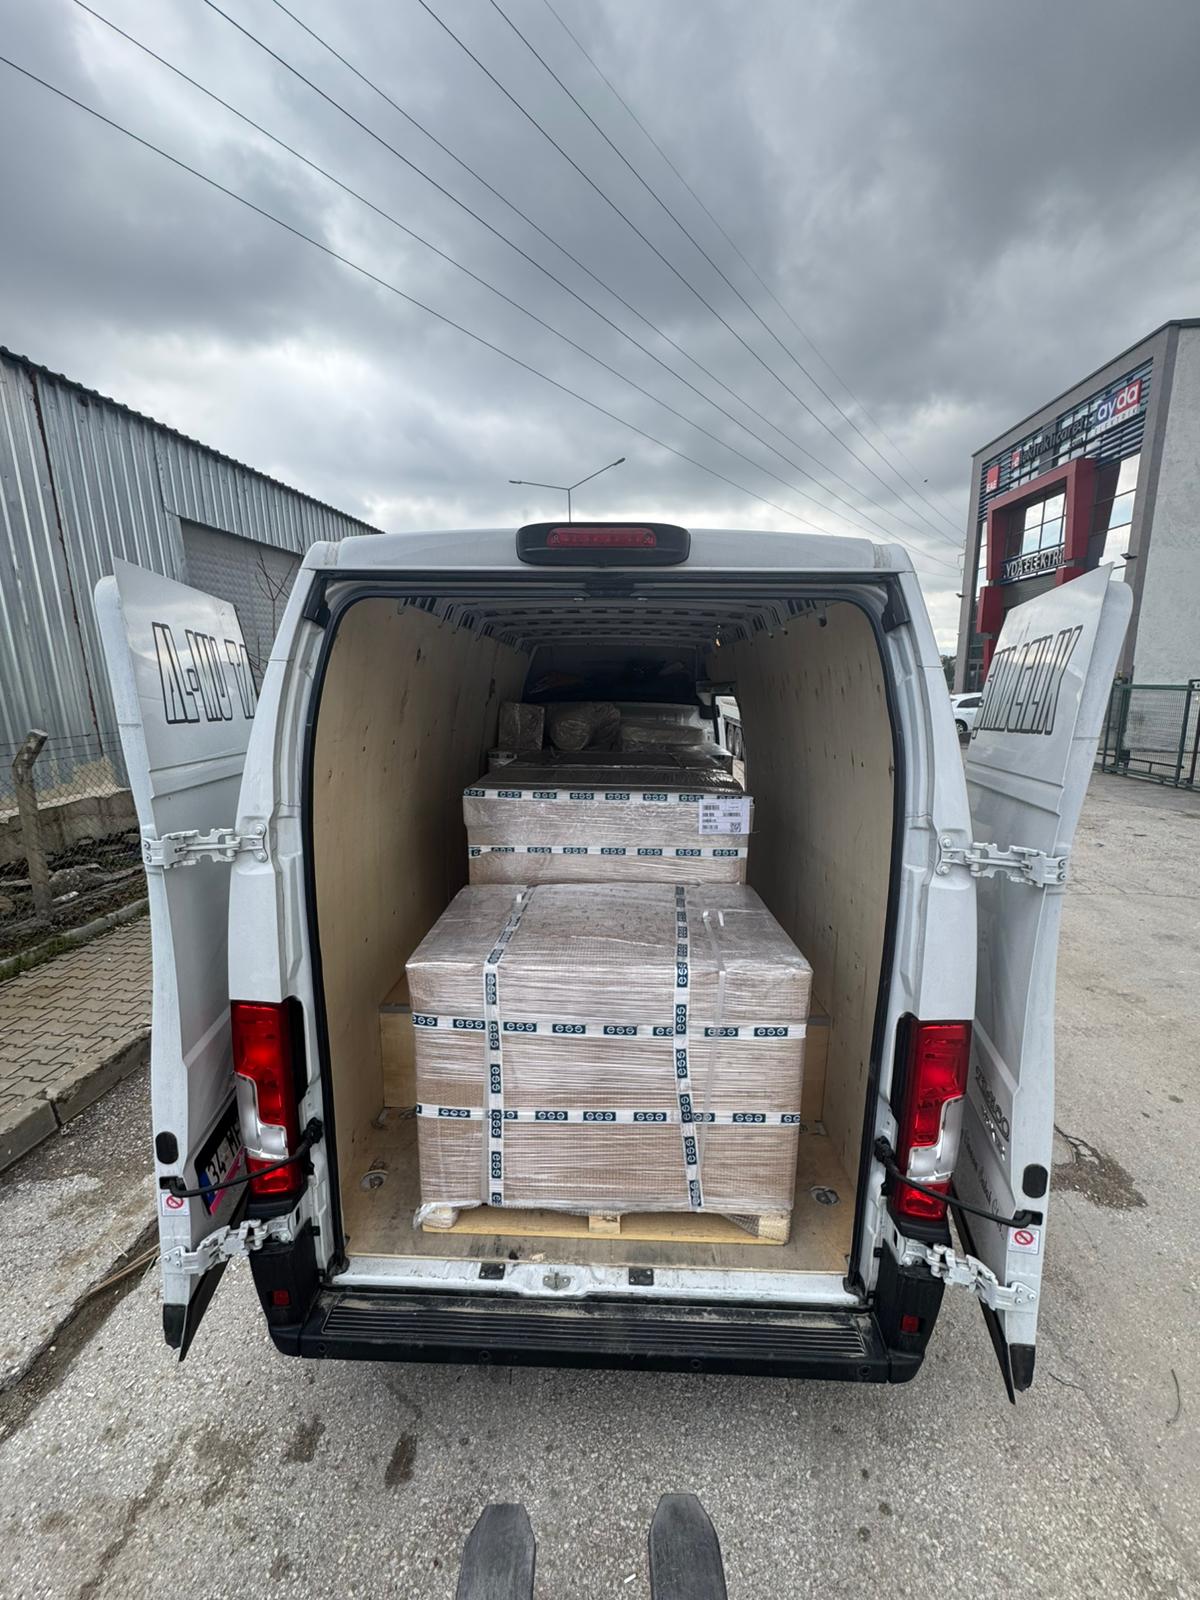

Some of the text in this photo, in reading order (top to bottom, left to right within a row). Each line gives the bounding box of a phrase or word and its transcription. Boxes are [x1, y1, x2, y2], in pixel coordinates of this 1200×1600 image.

[1098, 384, 1138, 420] ayda
[151, 621, 233, 725] AL-MU
[455, 1020, 485, 1029] ess
[506, 1022, 536, 1032] ess
[555, 1024, 584, 1033] ess
[606, 1026, 635, 1035] ess
[757, 1027, 786, 1036] ess
[491, 1067, 501, 1091] ess
